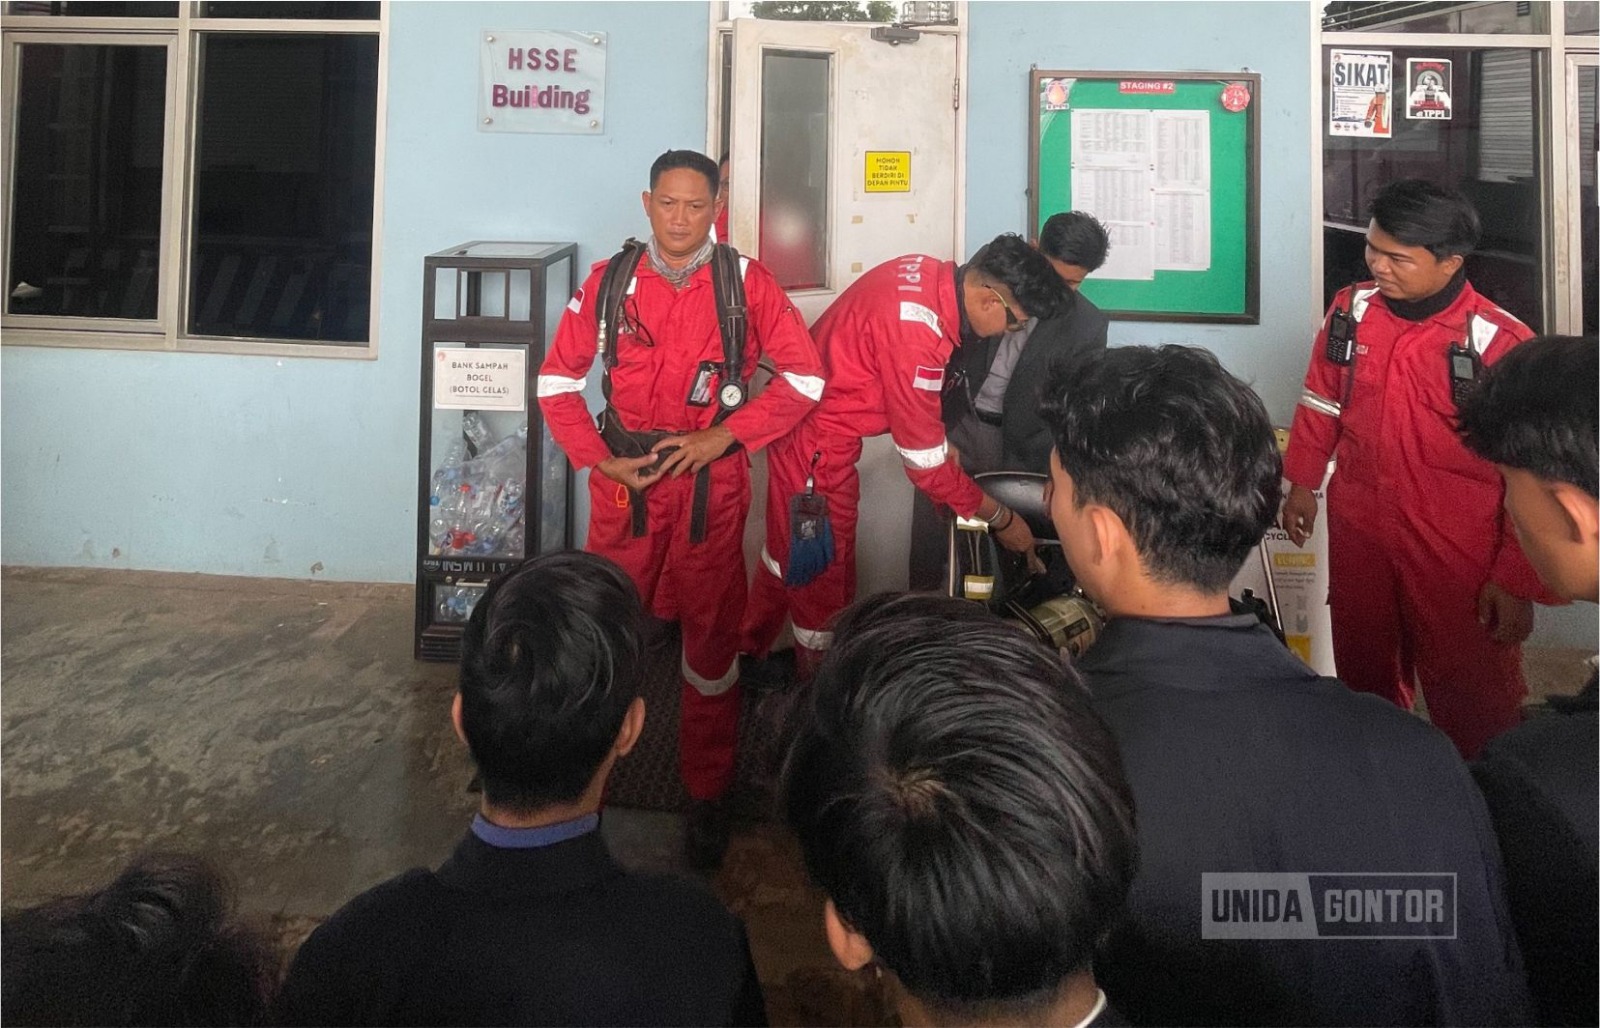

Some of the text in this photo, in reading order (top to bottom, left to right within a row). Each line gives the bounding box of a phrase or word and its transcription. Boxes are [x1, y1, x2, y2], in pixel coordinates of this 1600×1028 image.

[508, 47, 577, 72] HSSE
[1120, 81, 1174, 90] STAGING #2
[1335, 62, 1387, 87] SIKAT
[492, 84, 591, 115] Building
[897, 255, 924, 293] TPPI
[475, 362, 508, 370] SAMPAH
[449, 385, 480, 394] (BOTOL
